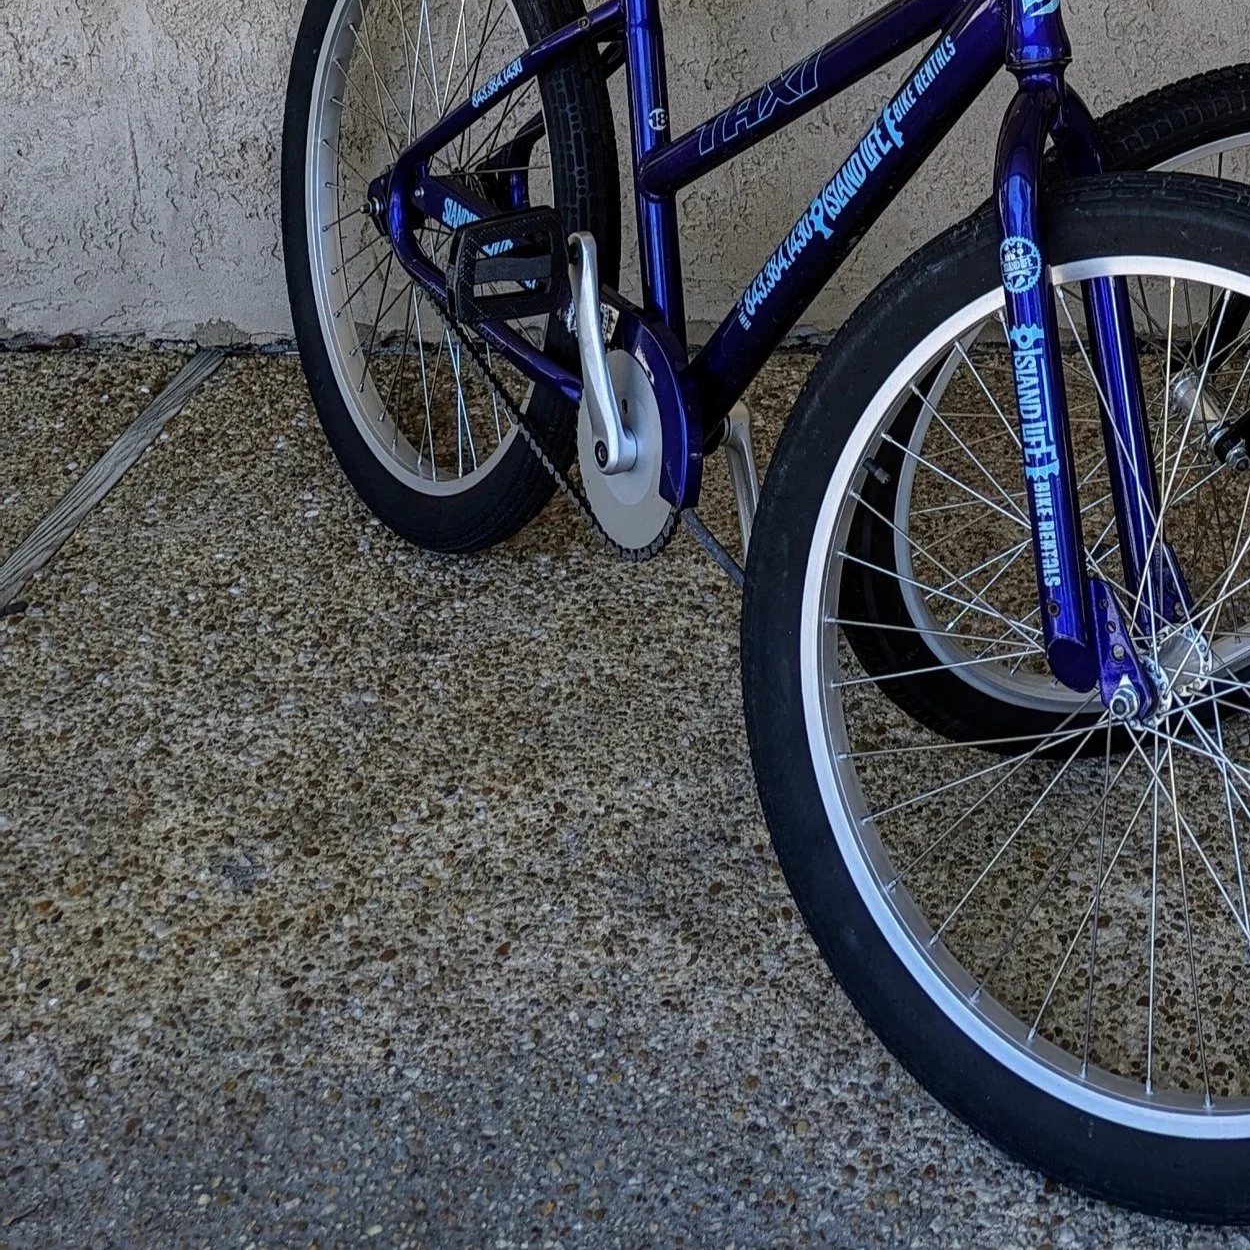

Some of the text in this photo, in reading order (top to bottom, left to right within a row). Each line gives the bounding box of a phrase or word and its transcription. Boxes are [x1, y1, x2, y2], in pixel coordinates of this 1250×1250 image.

[471, 57, 523, 107] 843.384.1430
[744, 217, 813, 316] 843.384.1430
[823, 161, 866, 220] ISLAND
[860, 122, 892, 172] LIFE
[891, 91, 917, 124] BIKE
[915, 35, 956, 97] RENTALS
[1013, 348, 1061, 587] ISLAND LIFE BIKE RENTALS
